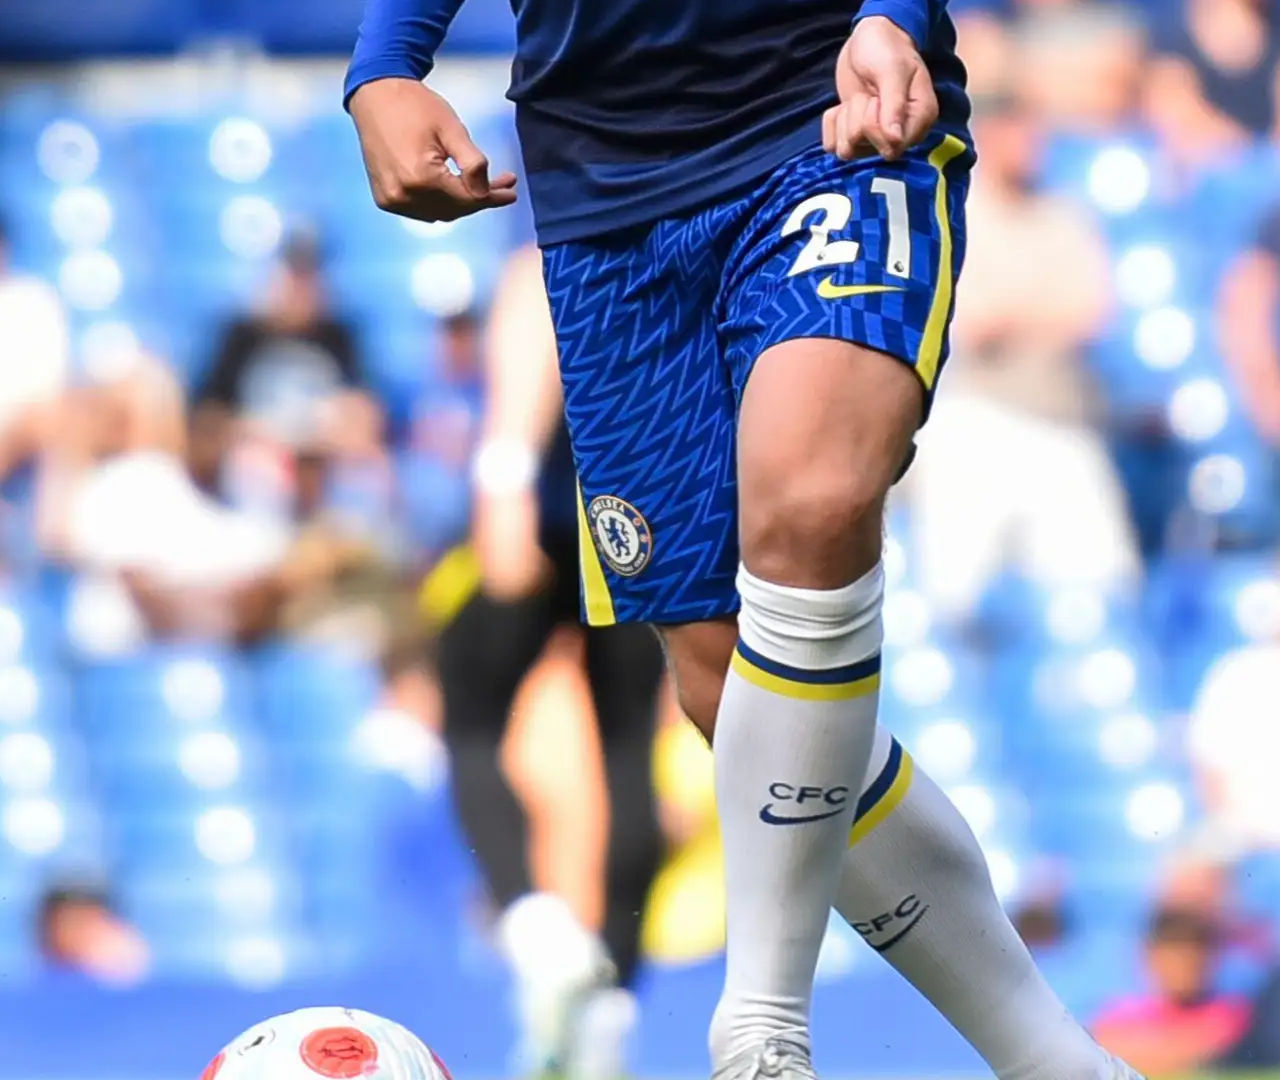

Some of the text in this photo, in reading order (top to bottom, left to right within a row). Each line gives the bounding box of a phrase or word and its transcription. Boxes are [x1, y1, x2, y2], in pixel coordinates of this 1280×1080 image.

[781, 177, 911, 279] 21
[769, 782, 849, 805] CFC
[852, 894, 920, 935] CFC
